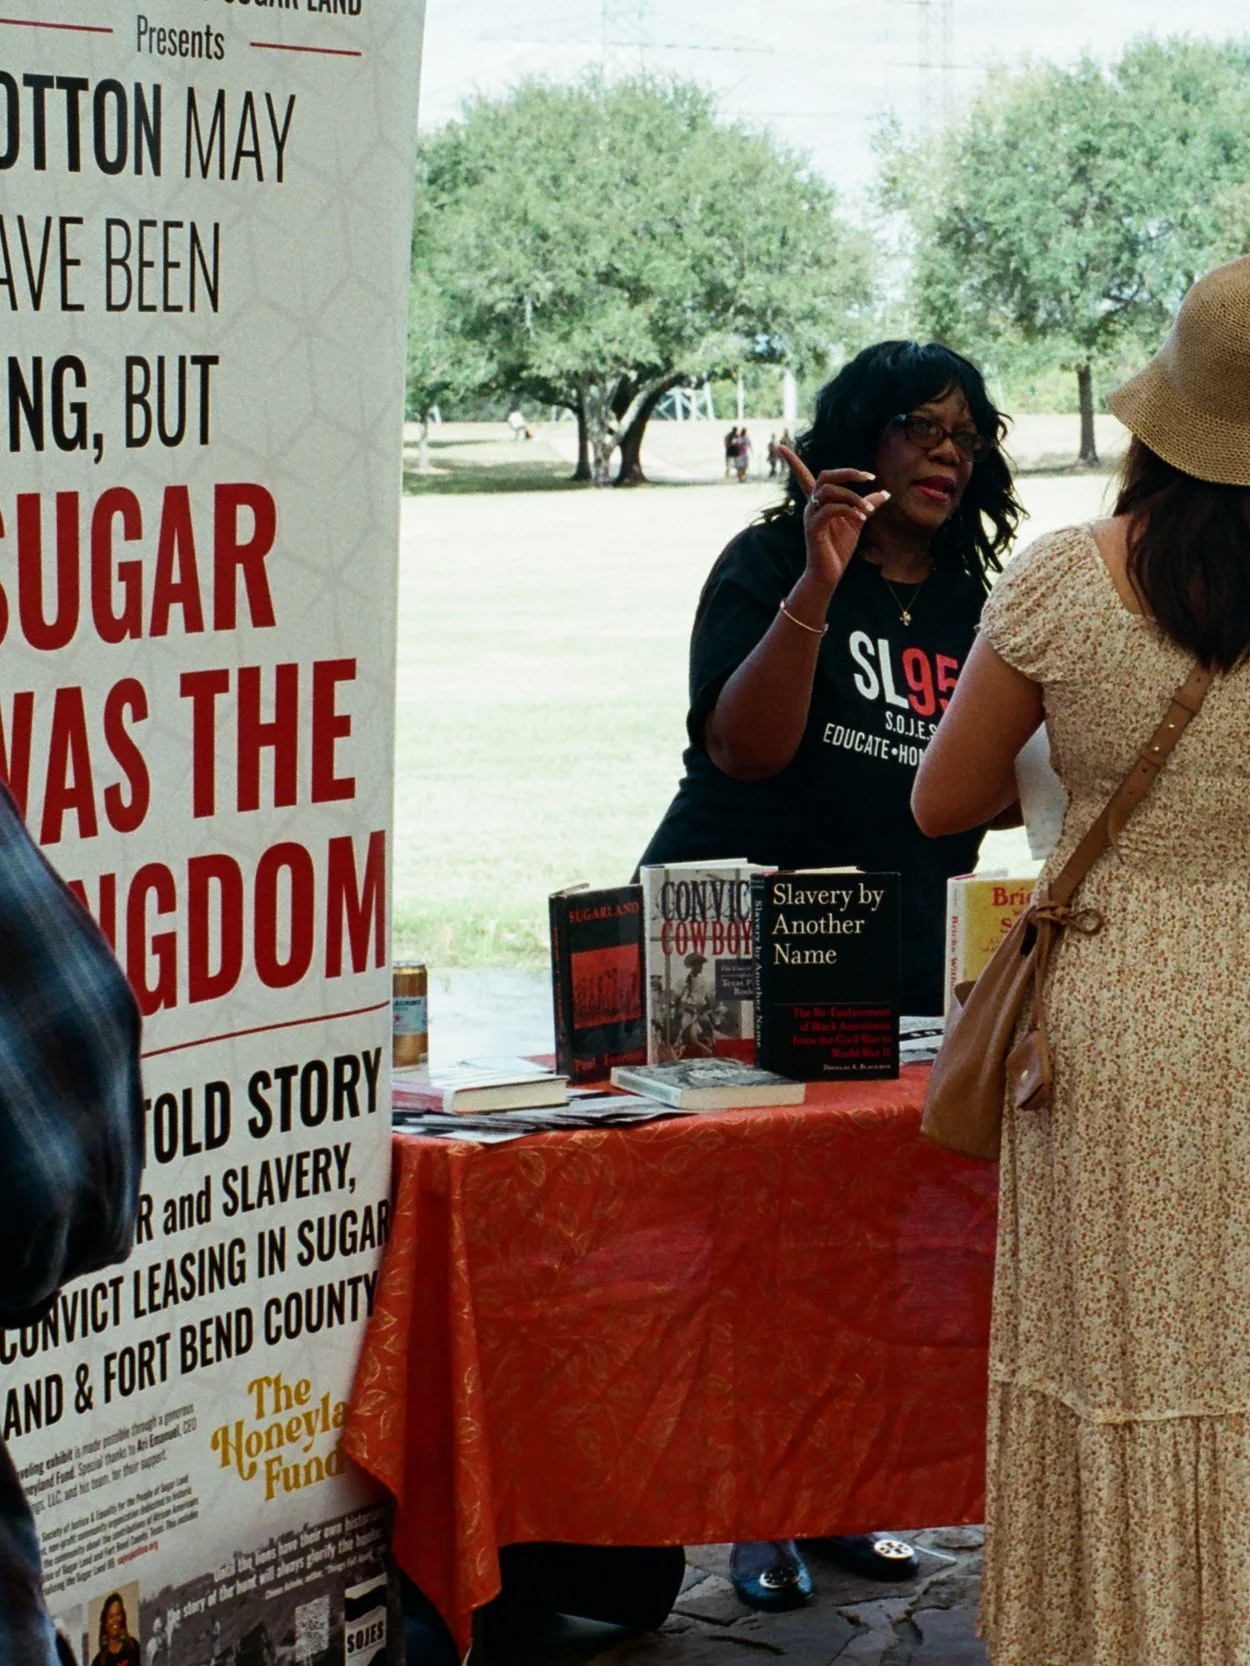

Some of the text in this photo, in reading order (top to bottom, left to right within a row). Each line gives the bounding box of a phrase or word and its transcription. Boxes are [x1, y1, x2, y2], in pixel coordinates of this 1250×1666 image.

[136, 15, 225, 60] Presents
[185, 87, 296, 183] MAY
[105, 217, 220, 313] BEEN
[125, 355, 219, 448] BUT
[0, 483, 277, 651] UGAR
[180, 658, 356, 819] THE
[568, 901, 640, 924] SUGARLAND
[661, 920, 752, 957] COWBOY
[771, 913, 865, 935] Another
[773, 882, 885, 912] Slavery by
[773, 943, 837, 965] Name
[247, 1047, 383, 1140] STORY
[163, 1142, 356, 1236] and SLAVERY,
[133, 1237, 246, 1319] LEASING
[258, 1226, 286, 1280] IN
[297, 1199, 390, 1268] SUGAR
[74, 1363, 94, 1415] &
[103, 1332, 171, 1405] FORT
[180, 1307, 254, 1376] BEND
[264, 1270, 378, 1347] COUNTY
[247, 1371, 312, 1421] The
[346, 1621, 384, 1654] SOJES
